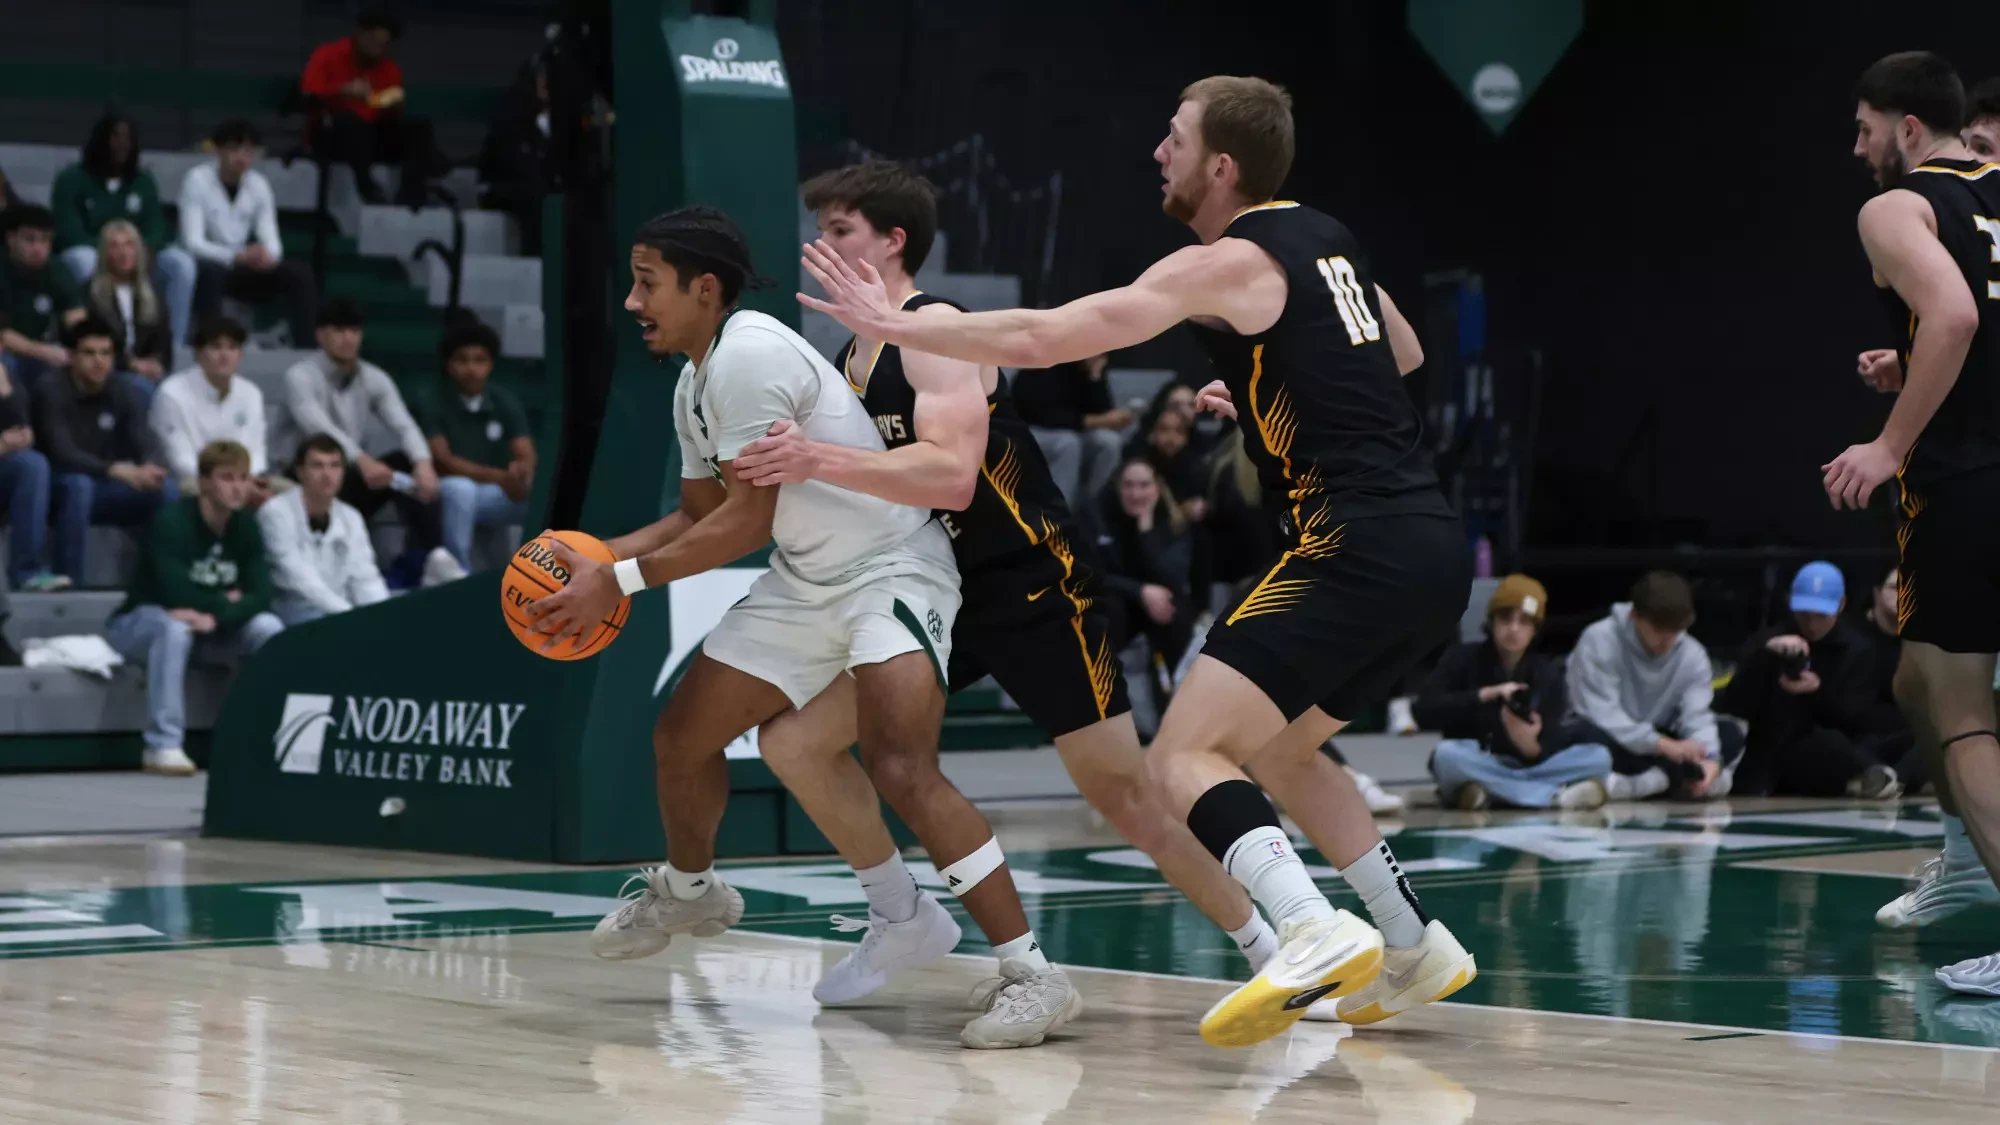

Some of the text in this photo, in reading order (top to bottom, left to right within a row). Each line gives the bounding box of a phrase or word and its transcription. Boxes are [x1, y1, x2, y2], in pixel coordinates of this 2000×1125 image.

[680, 54, 785, 87] SPALDING
[1316, 255, 1380, 346] 10
[872, 414, 907, 440] AYS
[506, 585, 536, 608] EV
[338, 696, 526, 749] NODAWAY
[334, 748, 513, 788] VALLEY BANK
